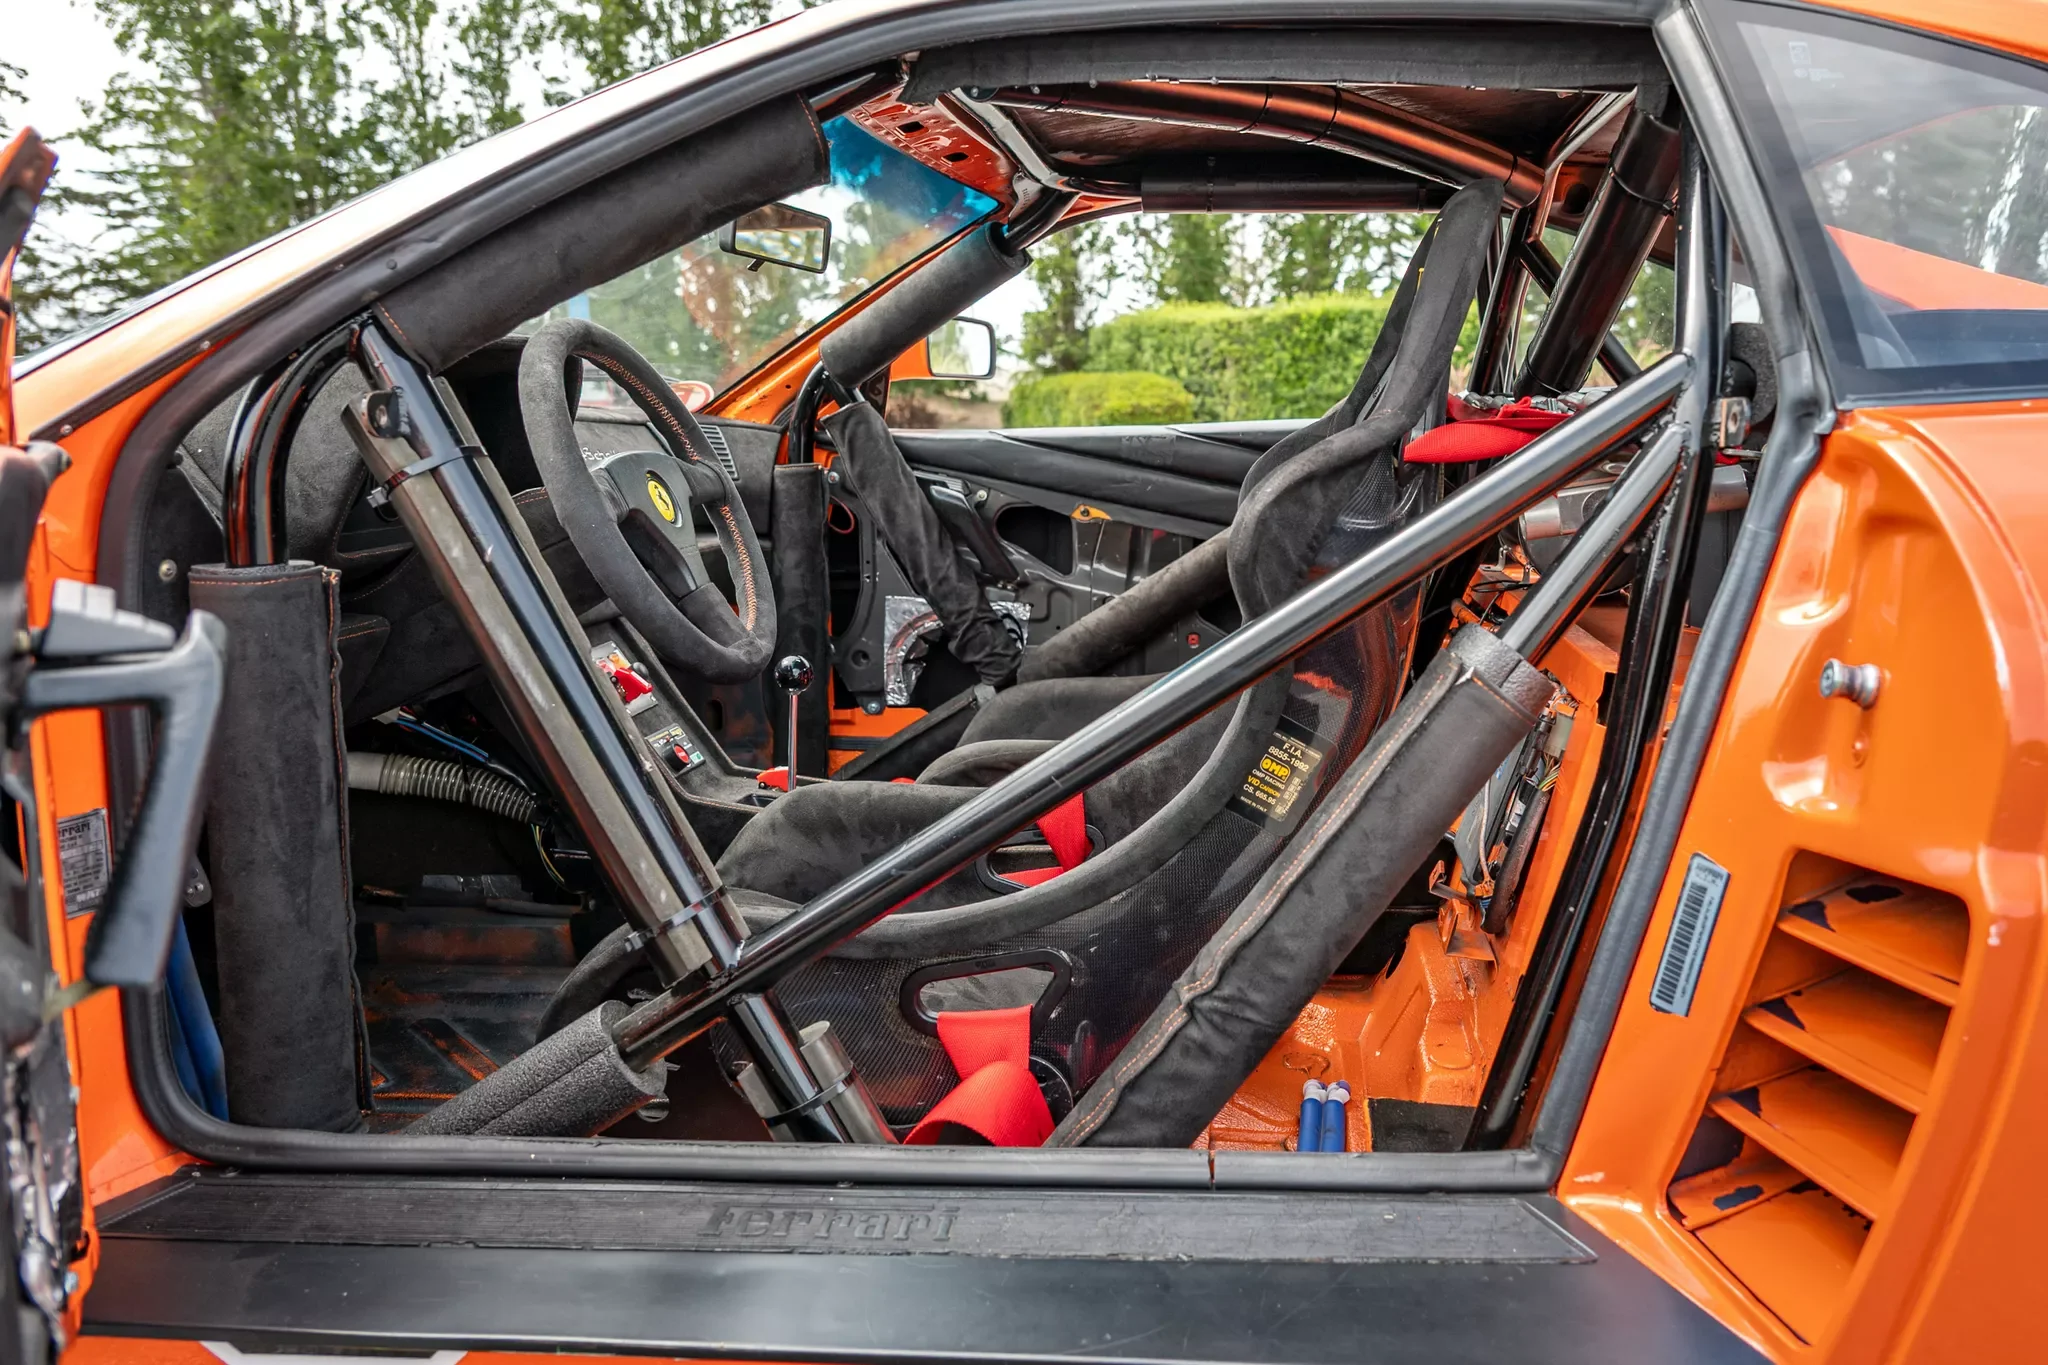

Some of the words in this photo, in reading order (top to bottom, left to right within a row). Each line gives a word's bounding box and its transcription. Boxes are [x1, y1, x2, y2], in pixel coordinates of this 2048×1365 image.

[1268, 746, 1309, 772] 8855-1992
[1283, 743, 1302, 759] F.I.A.
[1262, 758, 1290, 778] OMP
[1243, 784, 1254, 795] CS.
[1247, 775, 1260, 786] VID
[1259, 783, 1281, 798] CARBON
[1252, 769, 1265, 779] OMP
[1265, 774, 1286, 790] RACING
[697, 1201, 961, 1242] Ferrari
